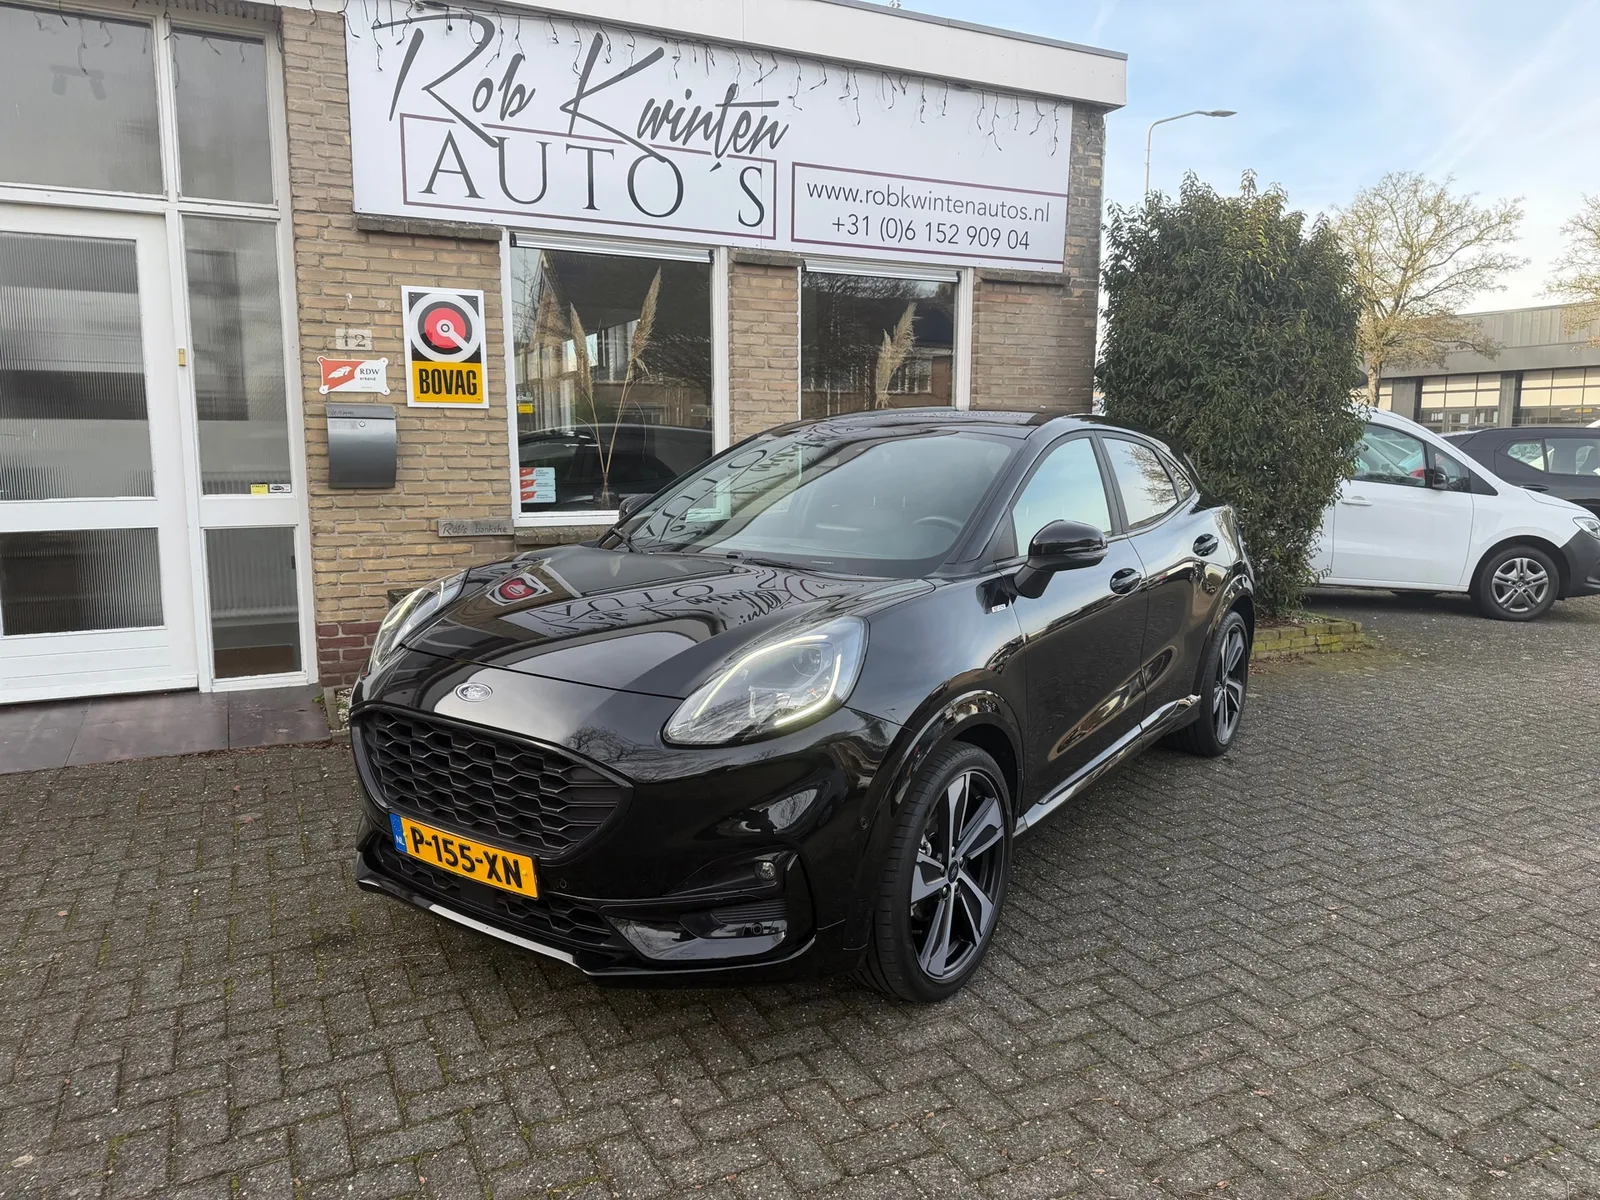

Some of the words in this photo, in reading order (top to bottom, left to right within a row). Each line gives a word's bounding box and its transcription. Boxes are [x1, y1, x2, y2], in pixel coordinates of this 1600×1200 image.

[371, 13, 536, 148] Rob
[559, 32, 790, 164] Kwinten
[806, 182, 1050, 223] www.robkwintenautos.nl
[831, 213, 870, 237] +31
[879, 216, 917, 243] (0)6
[924, 221, 960, 245] 152
[966, 225, 1001, 248] 909
[1007, 229, 1030, 251] 04
[418, 368, 478, 396] BOVAG
[395, 834, 405, 846] NL
[410, 826, 523, 889] P-155-XN
